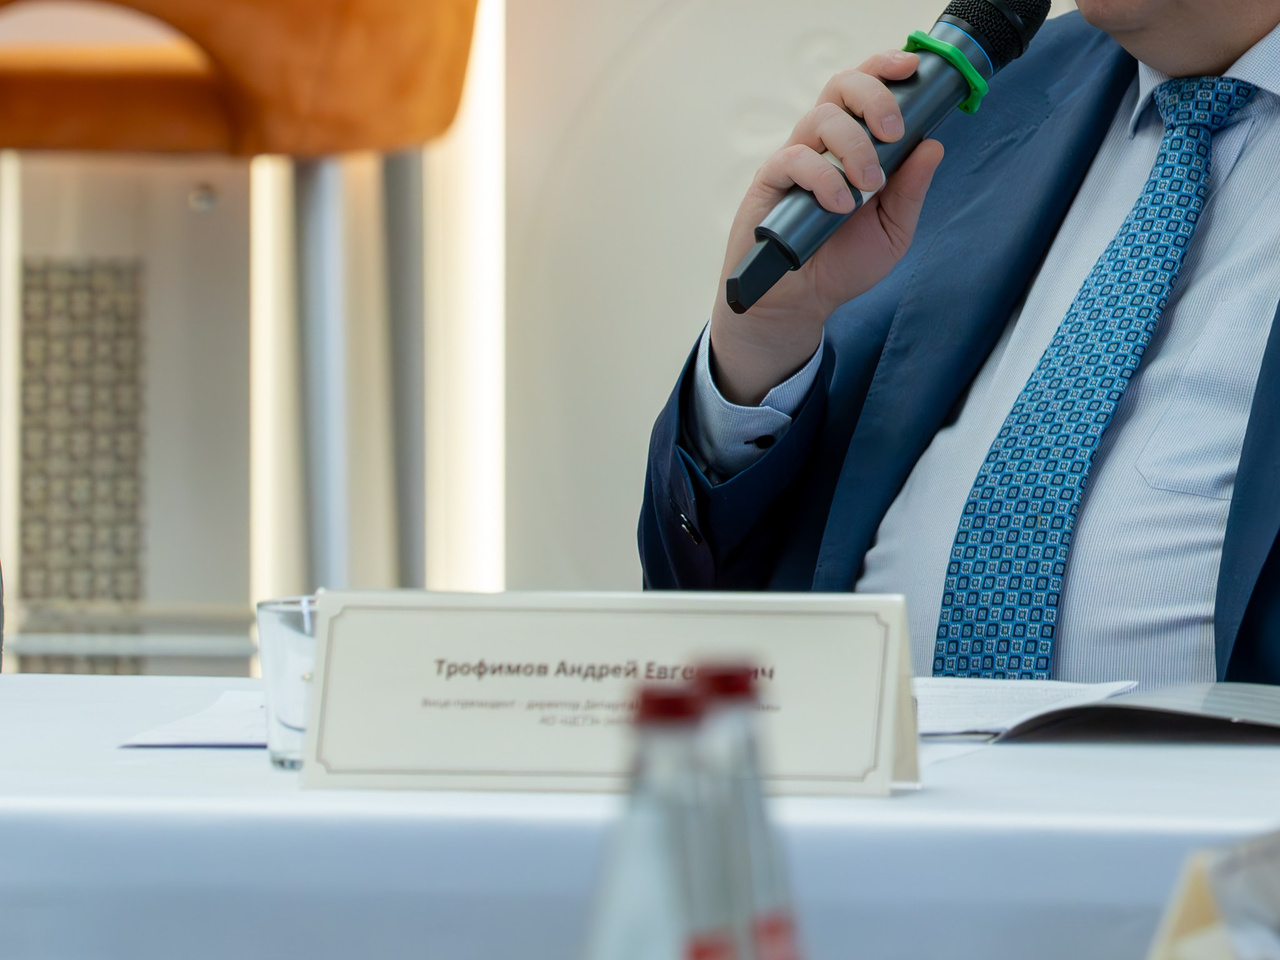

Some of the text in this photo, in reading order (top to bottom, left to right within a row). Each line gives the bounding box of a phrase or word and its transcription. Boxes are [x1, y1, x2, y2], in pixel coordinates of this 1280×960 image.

[434, 658, 775, 682] Трофимов Андрей Евгеич
